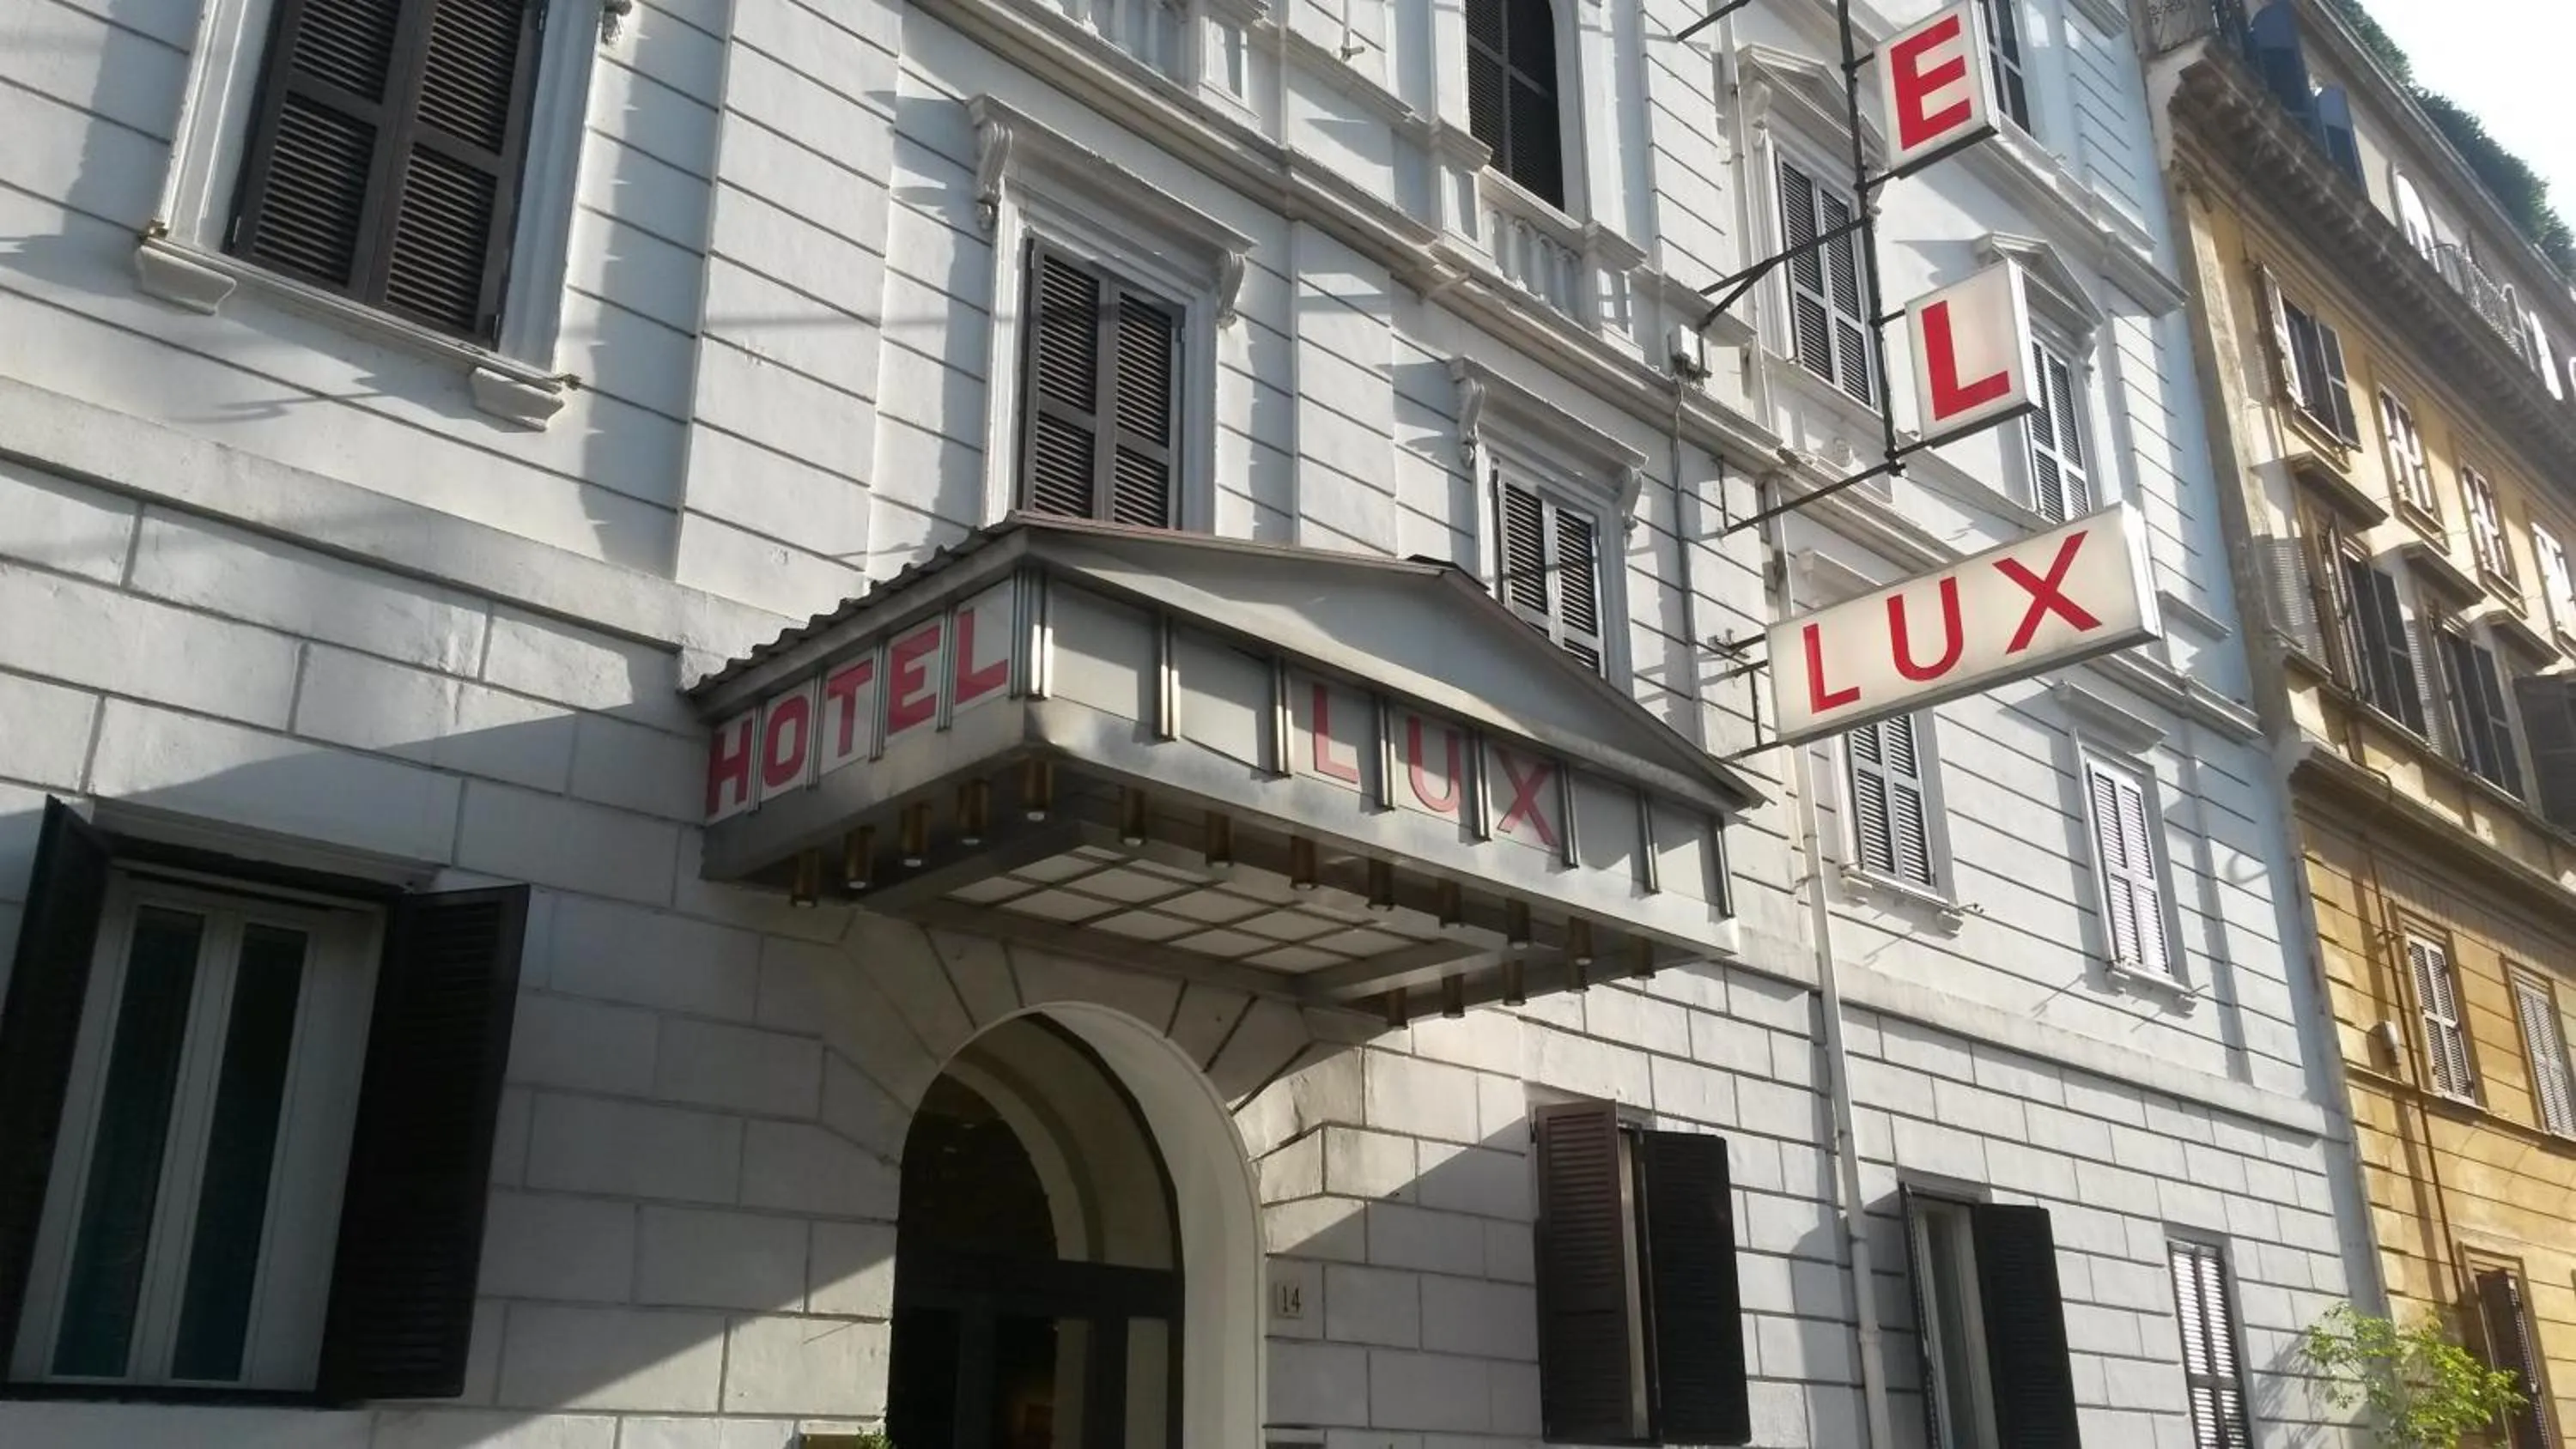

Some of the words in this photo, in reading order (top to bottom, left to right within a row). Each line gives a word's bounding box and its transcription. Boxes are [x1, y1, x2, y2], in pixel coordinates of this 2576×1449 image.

[1803, 530, 2103, 714] LUX
[706, 609, 1009, 819] HOTEL
[1312, 685, 1558, 846] LUX
[1282, 1286, 1302, 1313] 14
